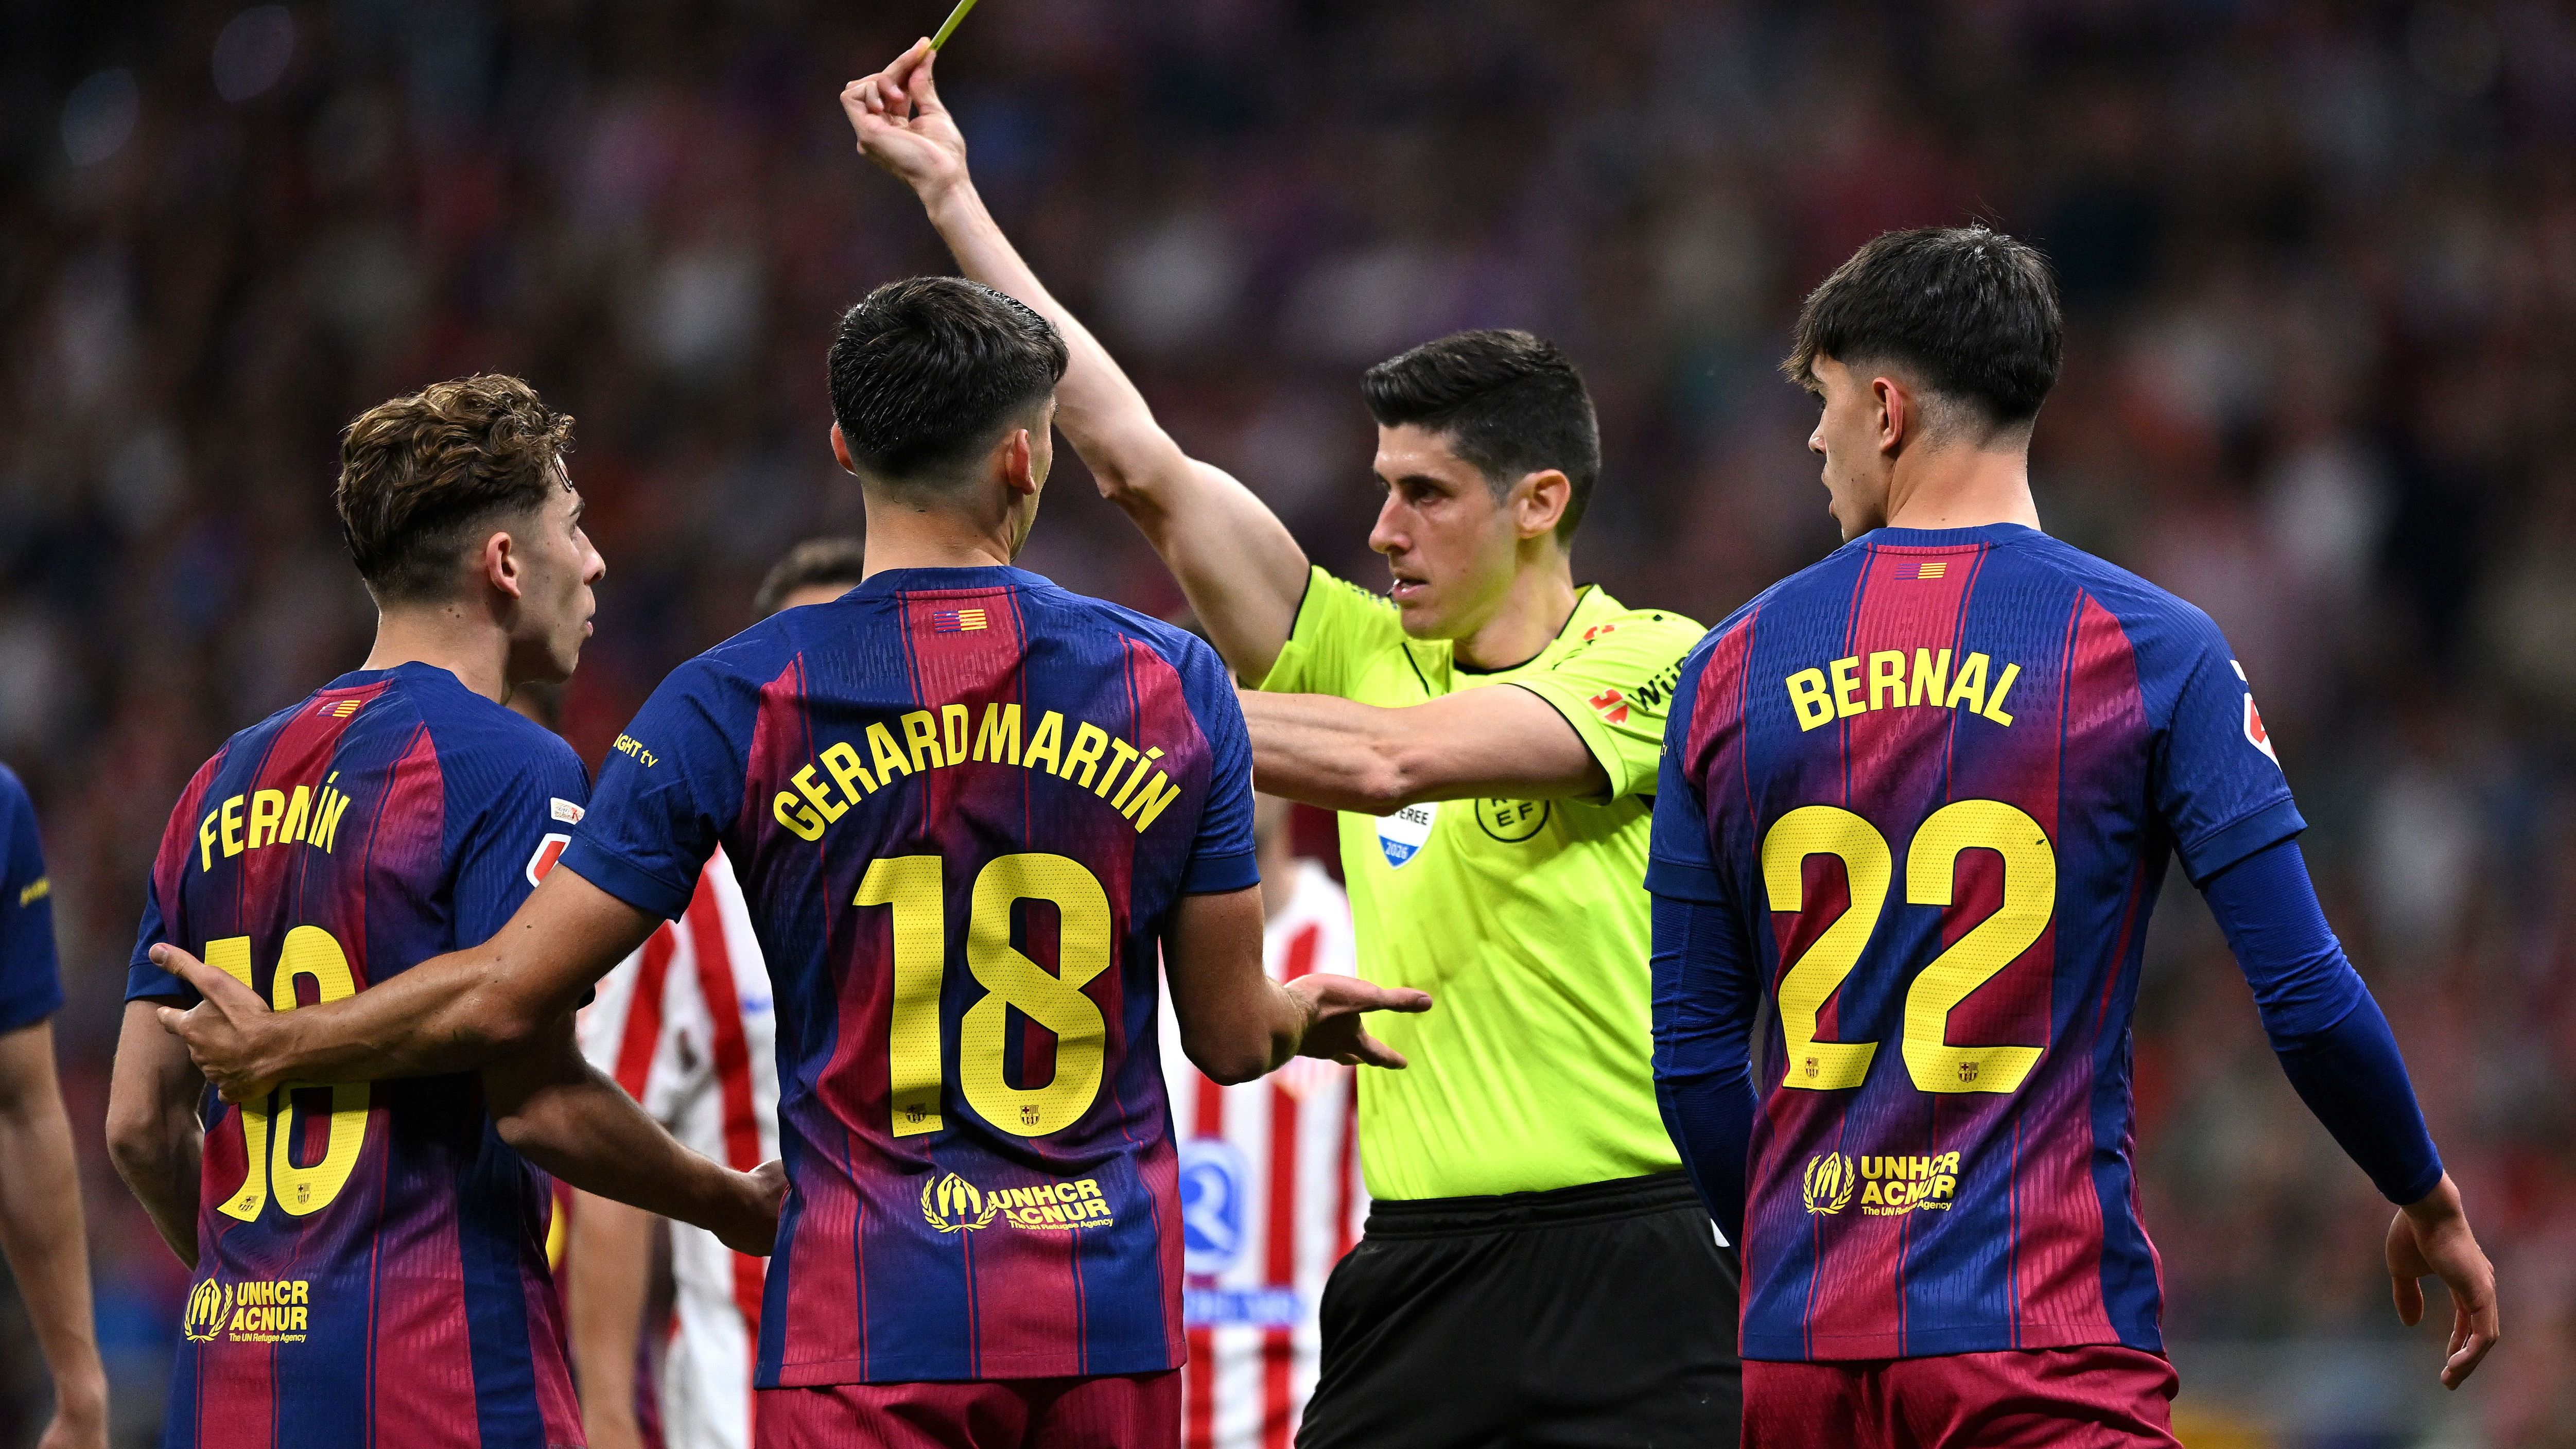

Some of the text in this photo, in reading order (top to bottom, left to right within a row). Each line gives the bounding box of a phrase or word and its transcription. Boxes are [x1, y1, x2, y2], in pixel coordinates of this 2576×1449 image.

[1785, 647, 2022, 733] BERNAL
[613, 732, 659, 768] IGHT tv
[199, 771, 351, 872] FERMÍN
[1398, 807, 1429, 826] EREE
[1385, 841, 1409, 860] 2026
[1761, 799, 2057, 1094] 22
[852, 852, 1112, 1138] 18
[1860, 1150, 1961, 1180] UNHCR
[987, 1179, 1103, 1209] UNHCR
[1860, 1175, 1957, 1206] ACNUR
[1004, 1198, 1112, 1225] ACNUR
[1861, 1206, 1880, 1216] The
[1881, 1207, 1895, 1216] UN
[1917, 1199, 1953, 1211] Agency
[1008, 1219, 1026, 1229] The
[1040, 1223, 1080, 1231] Refugee
[1080, 1218, 1114, 1228] Agency
[236, 1280, 309, 1306] UNHCR
[229, 1306, 308, 1332] ACNUR
[229, 1333, 307, 1344] The UN Refugee Agency
